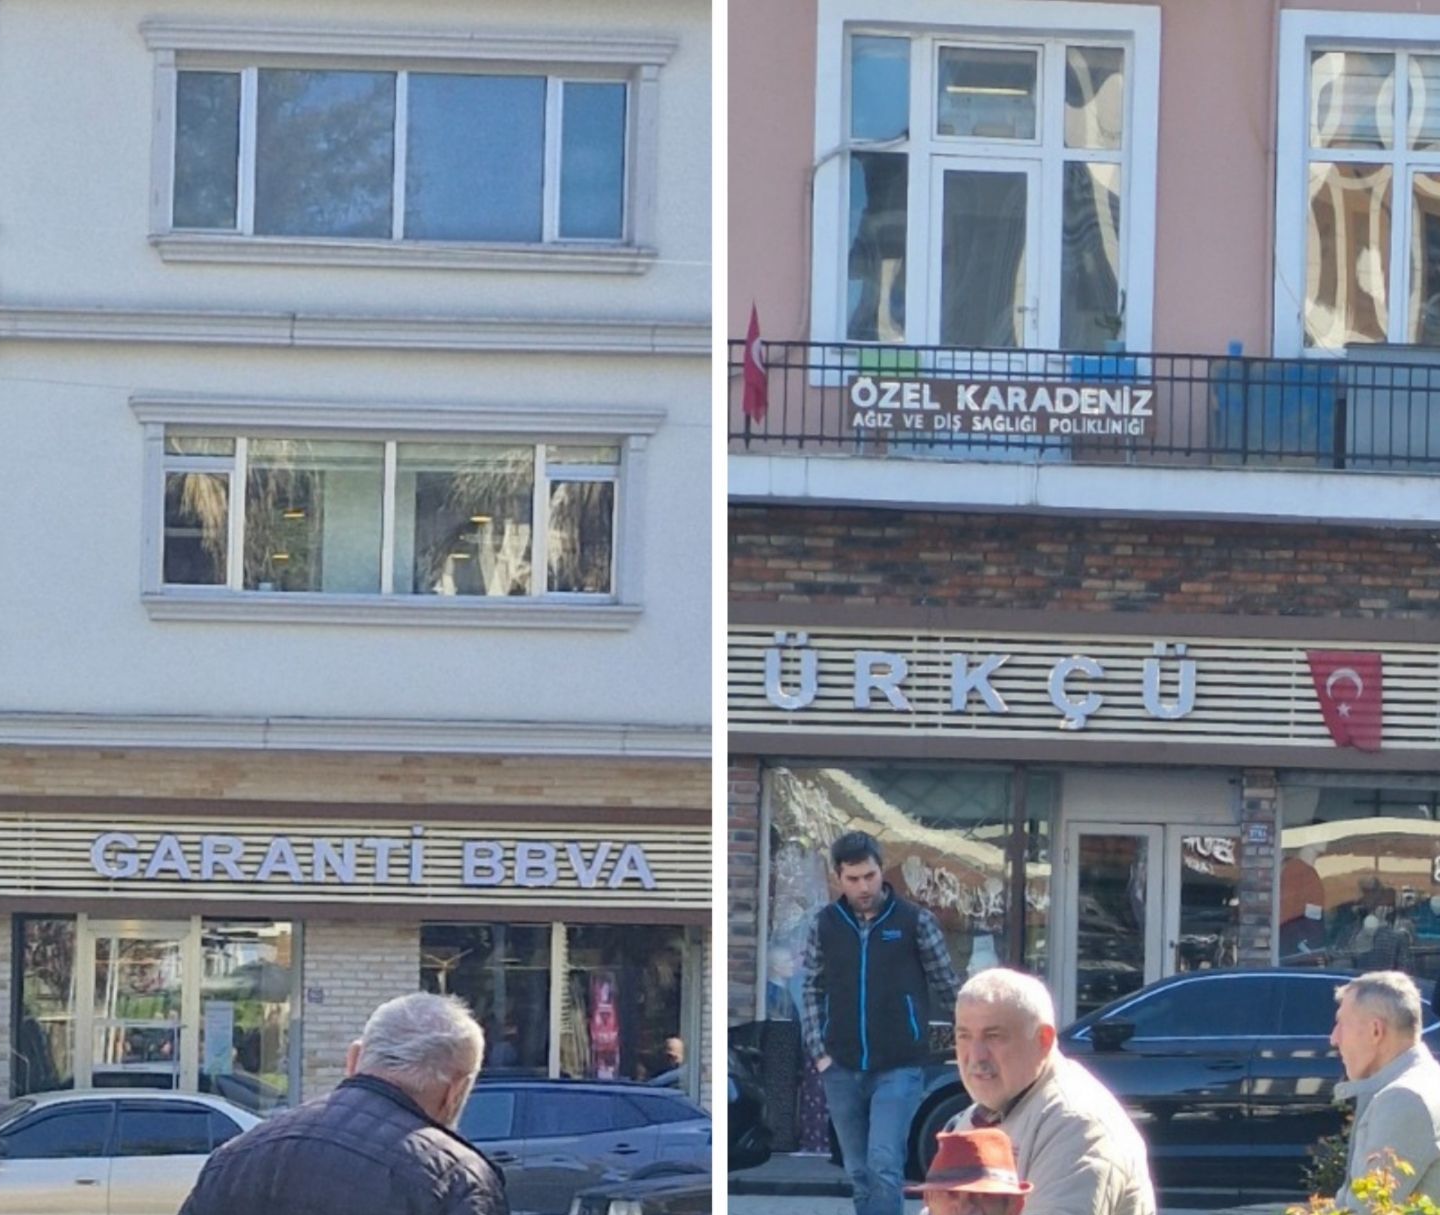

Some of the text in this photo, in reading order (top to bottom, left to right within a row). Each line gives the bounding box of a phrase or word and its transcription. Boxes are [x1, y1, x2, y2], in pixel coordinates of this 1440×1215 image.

[851, 377, 1153, 416] ÖZEL KARADENİZ
[852, 411, 893, 428] AĞIZ
[903, 413, 924, 429] VE
[933, 412, 962, 432] DİŞ
[972, 414, 1037, 433] SAĞLIĞI
[763, 629, 1197, 731] ÜRKÇÜ
[89, 823, 657, 890] GARANTİ BBVA
